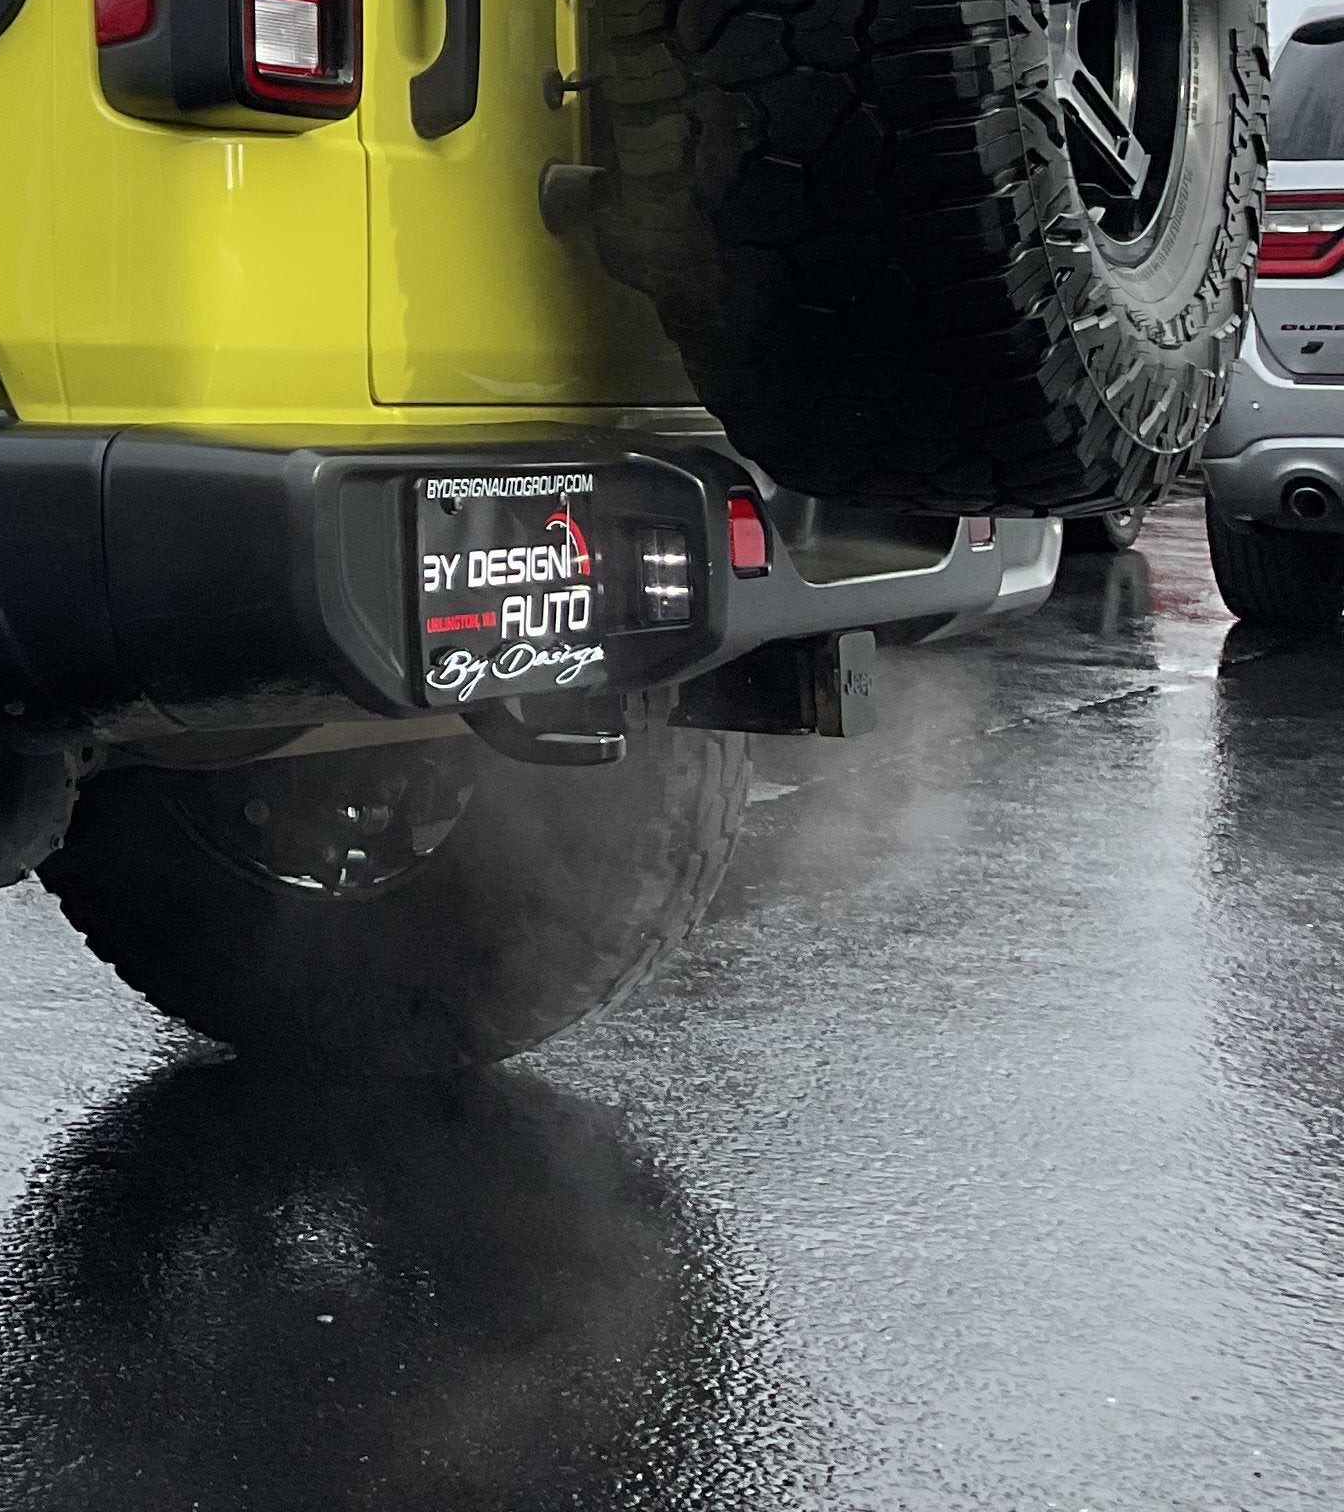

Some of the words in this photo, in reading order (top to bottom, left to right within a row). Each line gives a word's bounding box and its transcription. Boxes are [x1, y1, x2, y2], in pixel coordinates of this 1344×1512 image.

[427, 474, 593, 499] BYDESIGNAUTOGROUP.COM
[422, 553, 461, 592] BY
[467, 544, 570, 588] DESIGN
[501, 589, 591, 639] AUTO
[425, 650, 489, 702] By
[491, 643, 605, 685] Design
